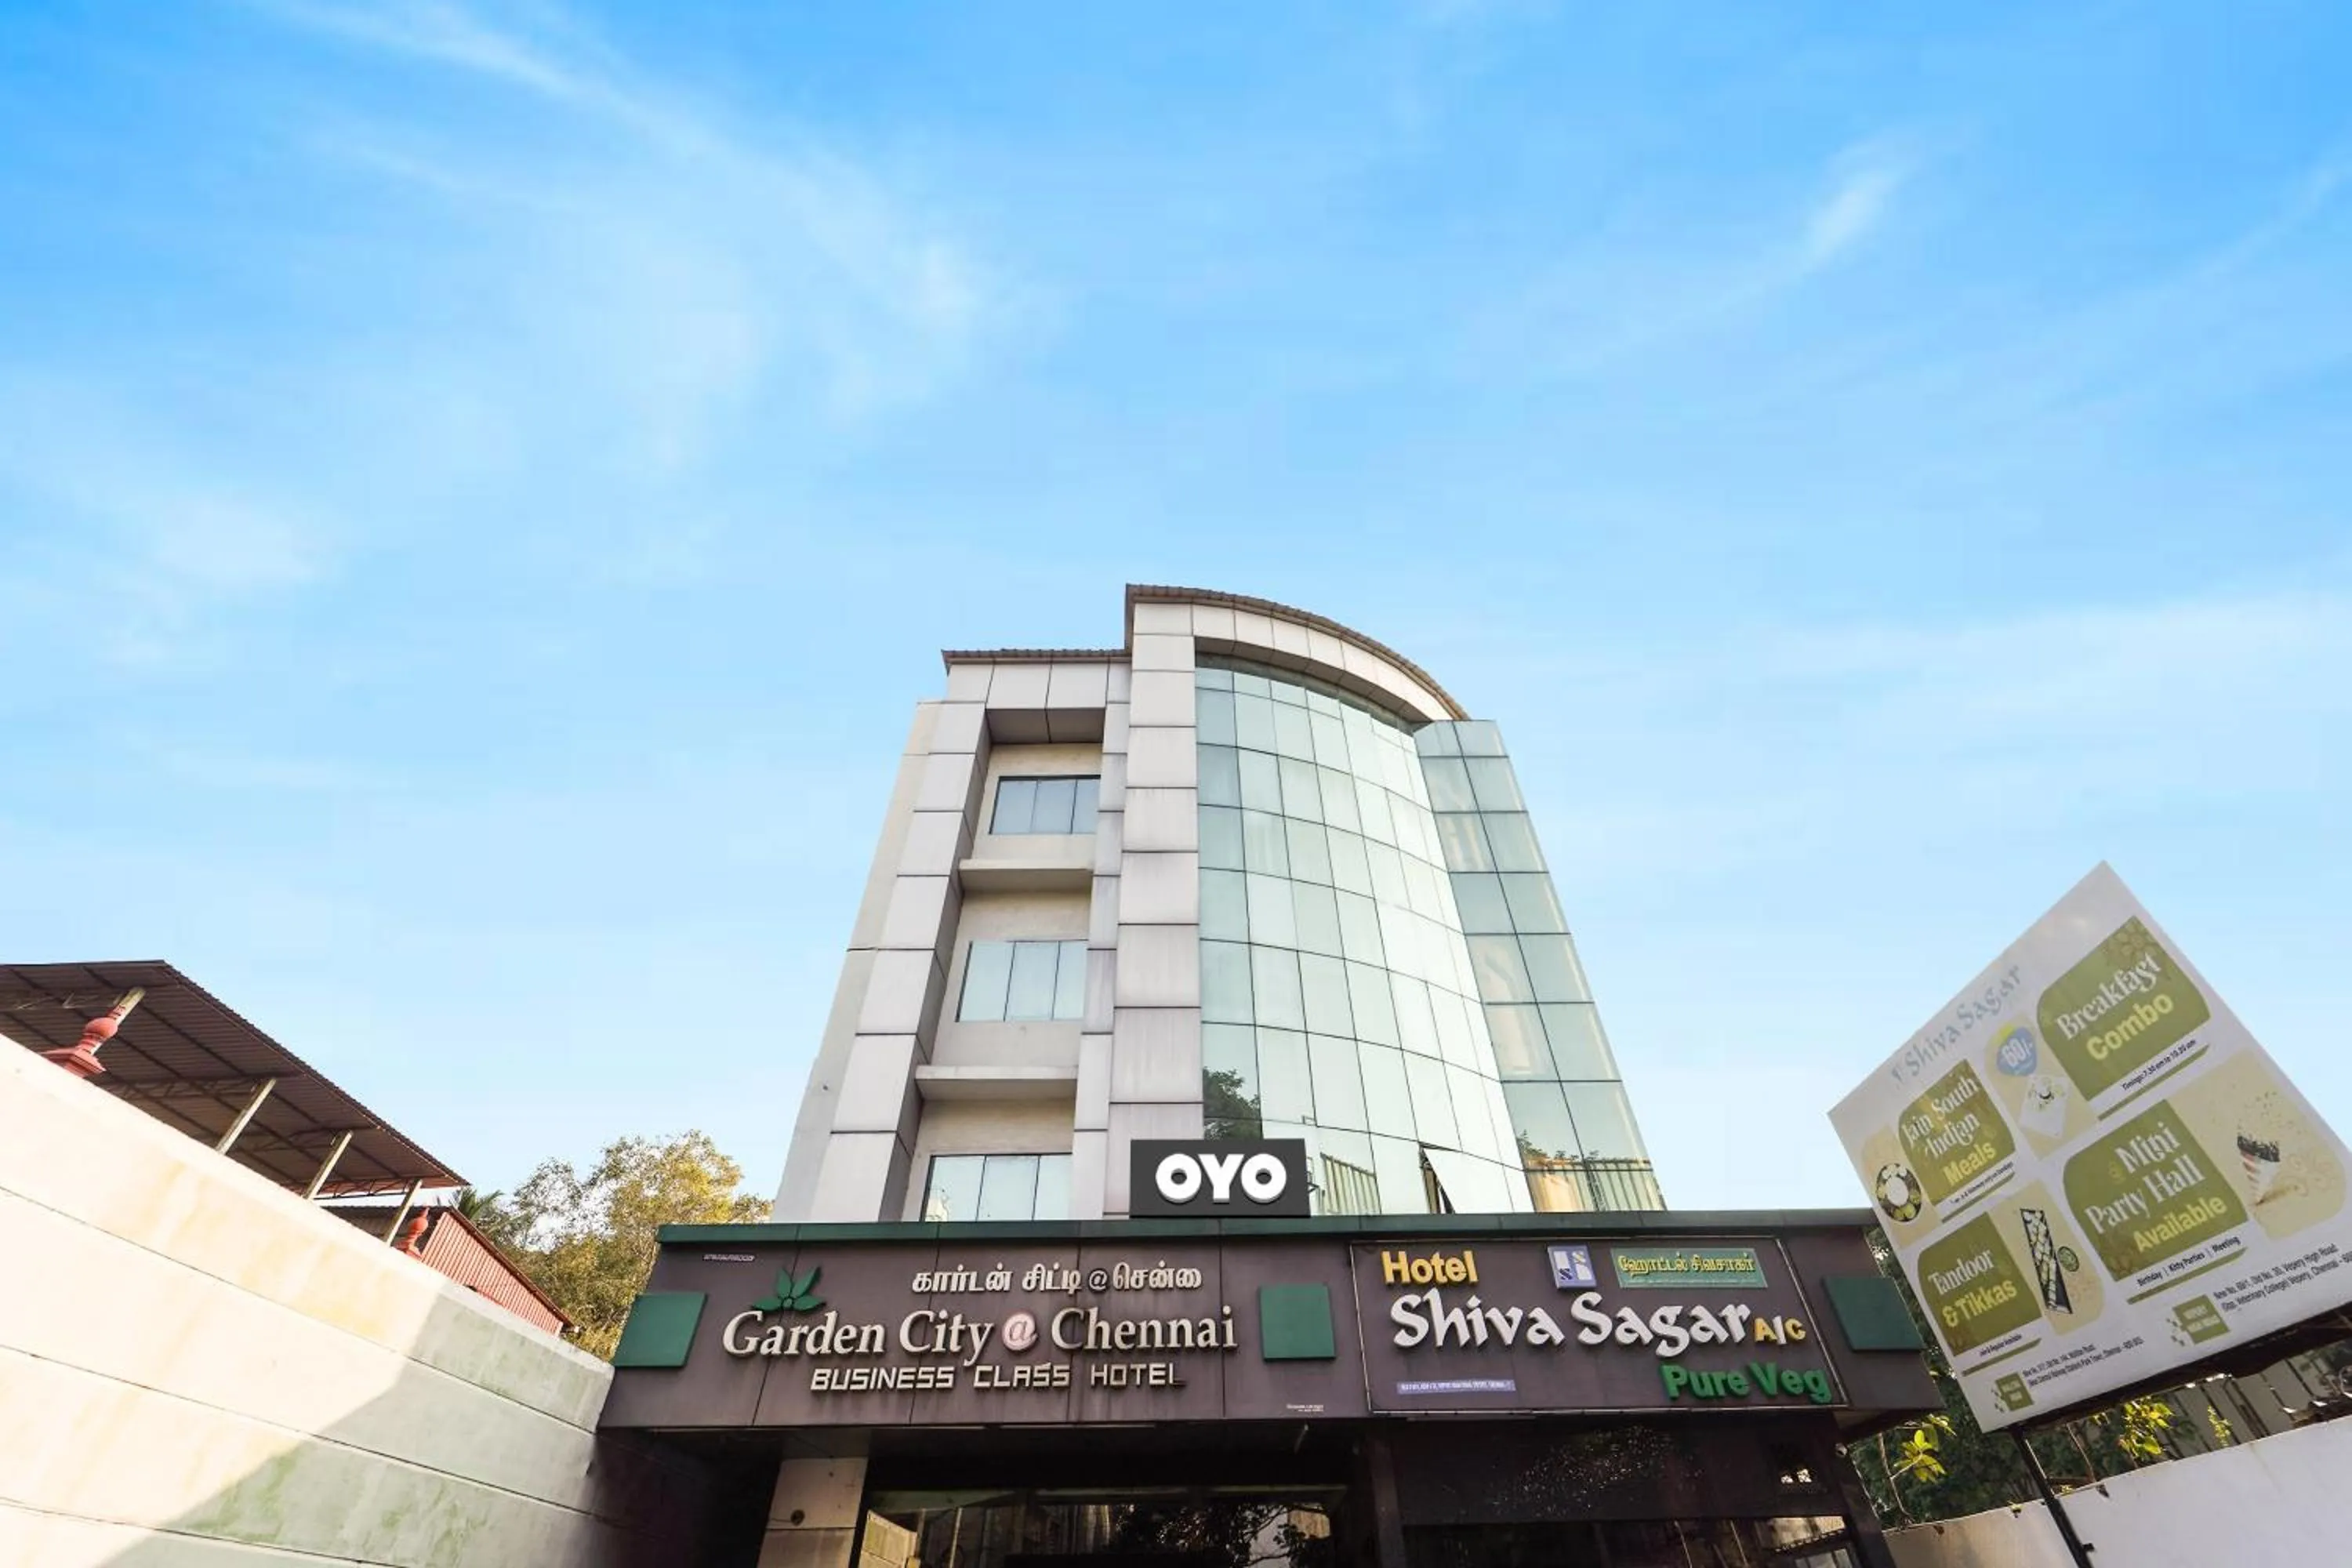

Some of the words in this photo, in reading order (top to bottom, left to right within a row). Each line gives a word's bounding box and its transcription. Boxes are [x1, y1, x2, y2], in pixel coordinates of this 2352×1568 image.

[1904, 1025, 1962, 1076] Shiva
[1957, 965, 2020, 1029] Sagar
[2056, 952, 2161, 1040] Breakfast
[2086, 993, 2174, 1060] Combo
[1931, 1076, 1980, 1119] South
[1942, 1142, 1997, 1186] Meals
[2114, 1120, 2181, 1174] Mini
[1155, 1152, 1287, 1203] OYO
[2084, 1189, 2151, 1234] Party
[2142, 1153, 2206, 1203] Hall
[2132, 1196, 2228, 1253] Available
[912, 1262, 1014, 1293] கார்டன்
[1022, 1261, 1081, 1294] சிட்டி
[1381, 1250, 1479, 1286] Hotel
[1927, 1250, 1994, 1295] Tandoor
[722, 1310, 886, 1356] Garden
[899, 1308, 994, 1367] City
[1051, 1305, 1239, 1351] Chennai
[1390, 1287, 1566, 1347] Shiva
[1570, 1291, 1751, 1357] Sagar
[810, 1367, 955, 1391] BUSINESS
[973, 1363, 1071, 1388] CLASS
[1091, 1363, 1182, 1386] HOTEL
[1659, 1363, 1751, 1399] Pure
[1748, 1361, 1832, 1404] Veg
